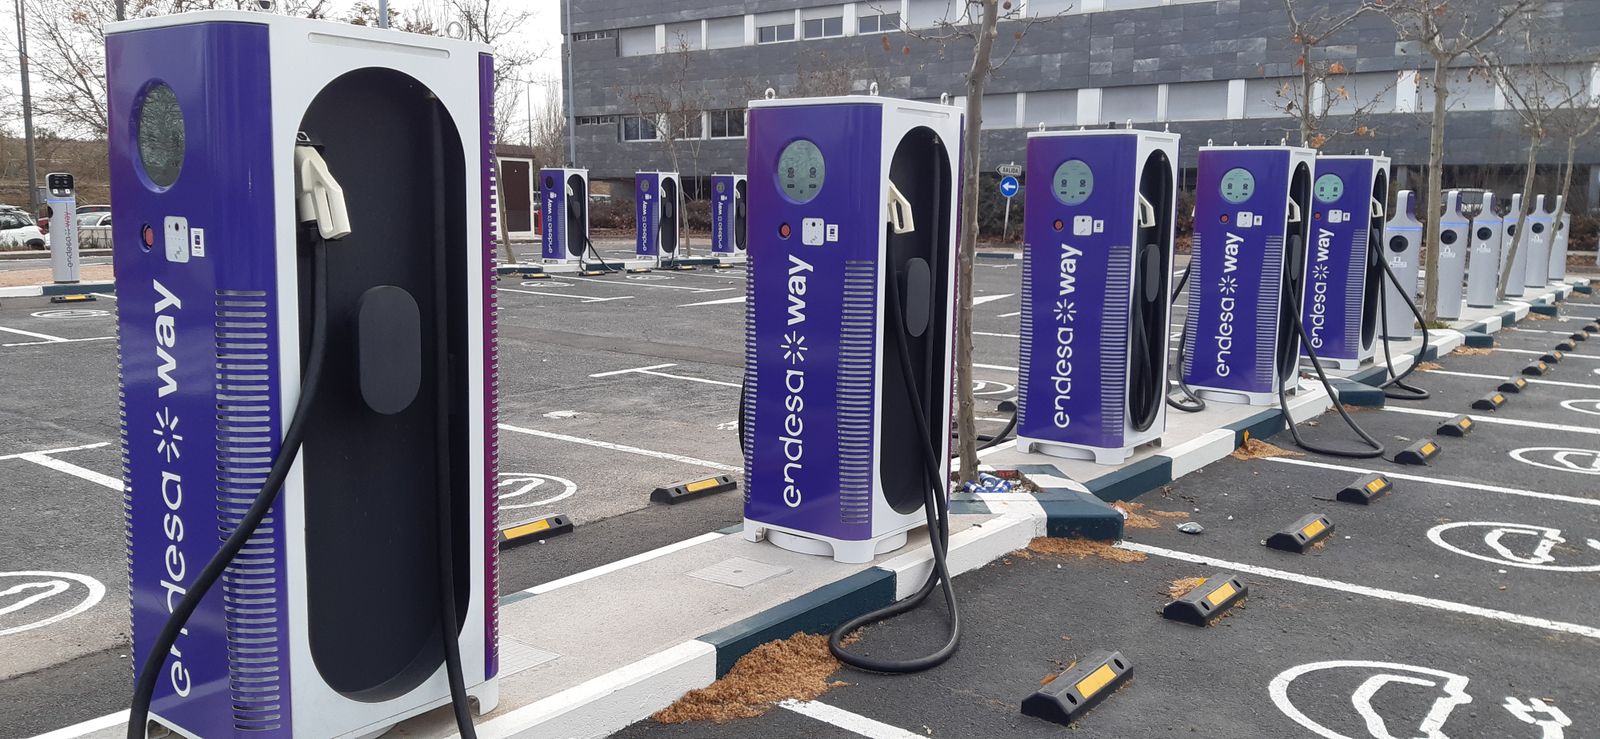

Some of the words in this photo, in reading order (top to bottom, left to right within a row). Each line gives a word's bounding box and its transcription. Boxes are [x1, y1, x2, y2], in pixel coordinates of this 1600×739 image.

[1060, 243, 1083, 296] way
[1223, 231, 1244, 273] way
[1316, 228, 1335, 262] way
[787, 254, 814, 326] way
[1310, 281, 1328, 349] endesa
[153, 279, 181, 398] way
[1215, 297, 1236, 378] endesa
[1050, 326, 1074, 429] endesa
[778, 370, 805, 508] endesa
